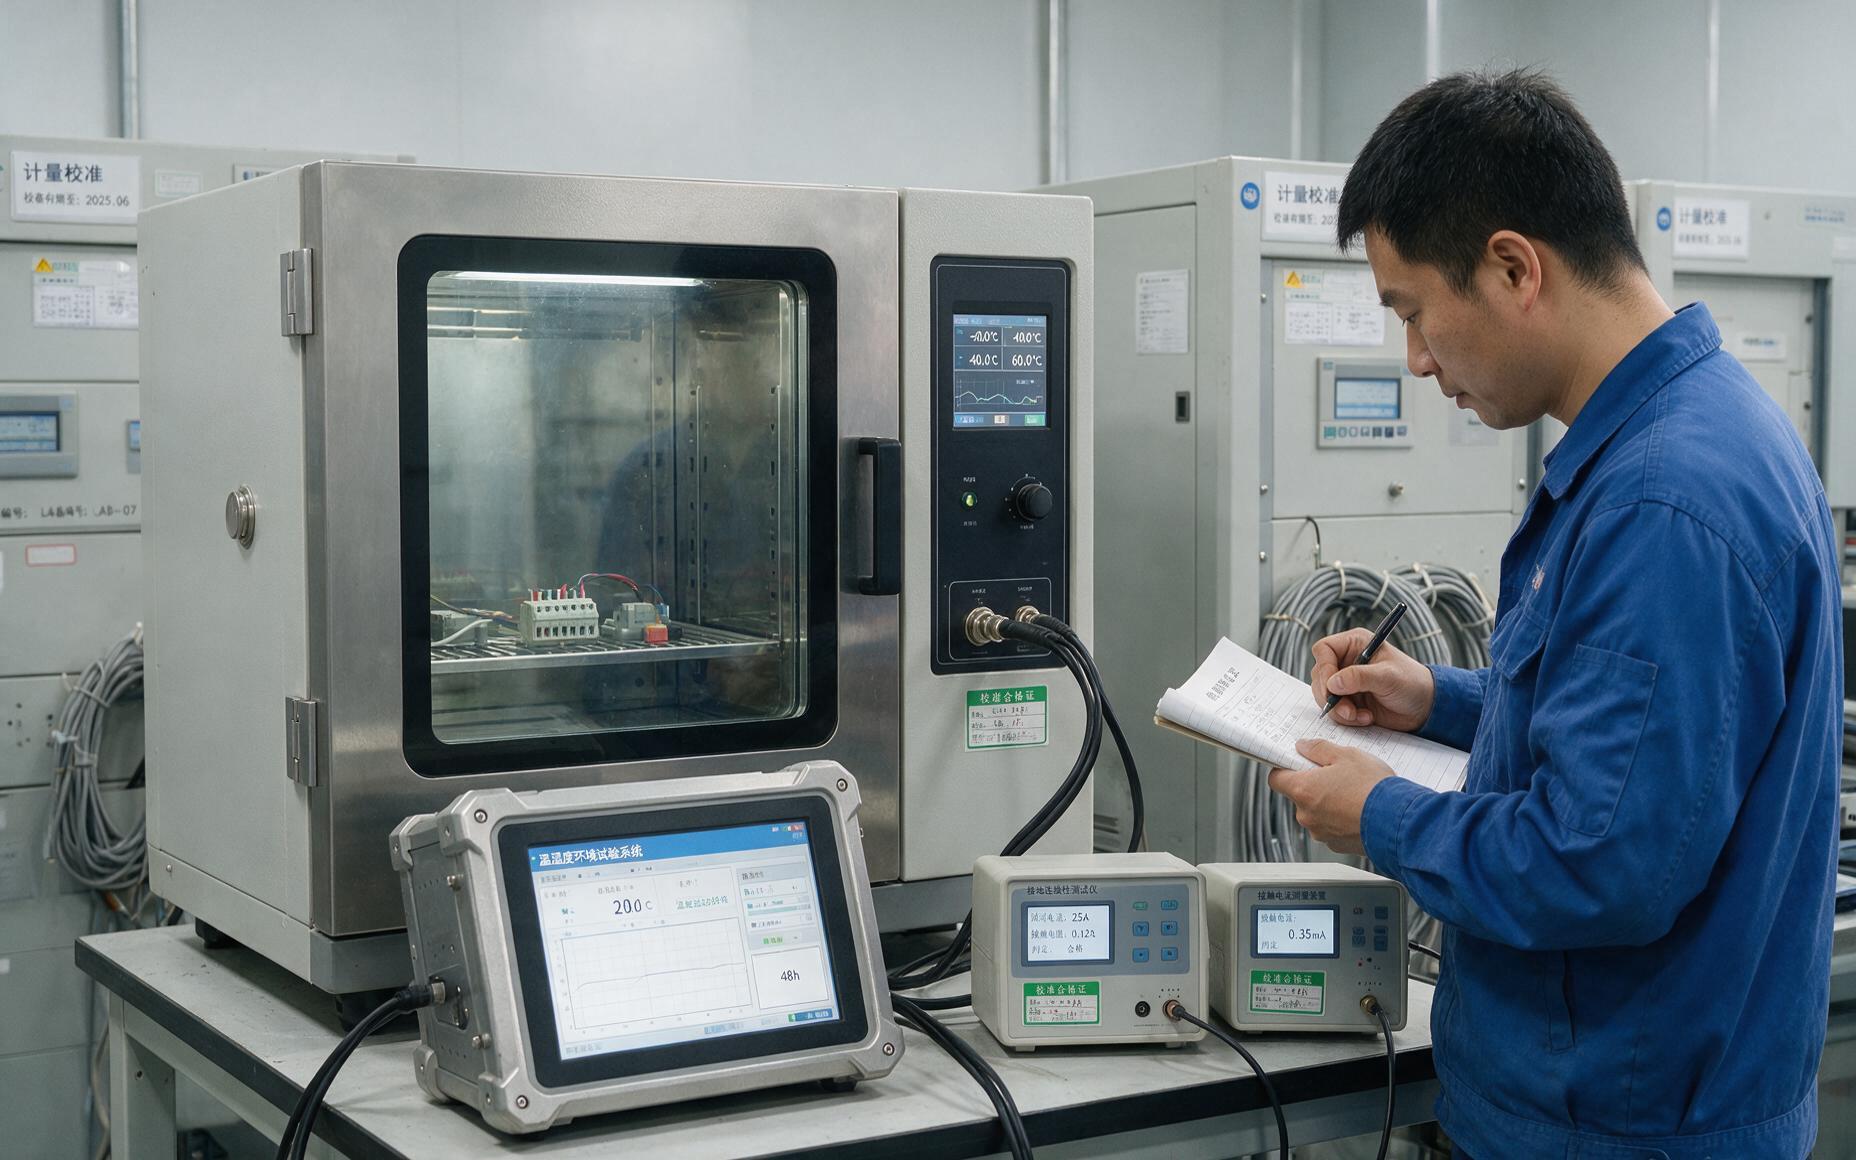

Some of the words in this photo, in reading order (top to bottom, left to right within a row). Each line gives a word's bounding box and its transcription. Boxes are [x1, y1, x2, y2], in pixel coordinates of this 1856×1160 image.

[24, 162, 103, 183] 计量校准
[86, 194, 130, 207] 2025.06
[981, 690, 1035, 704] 校准合格证
[1288, 928, 1327, 940] 0.35mA
[1067, 944, 1083, 954] 合格
[780, 969, 800, 982] 48h
